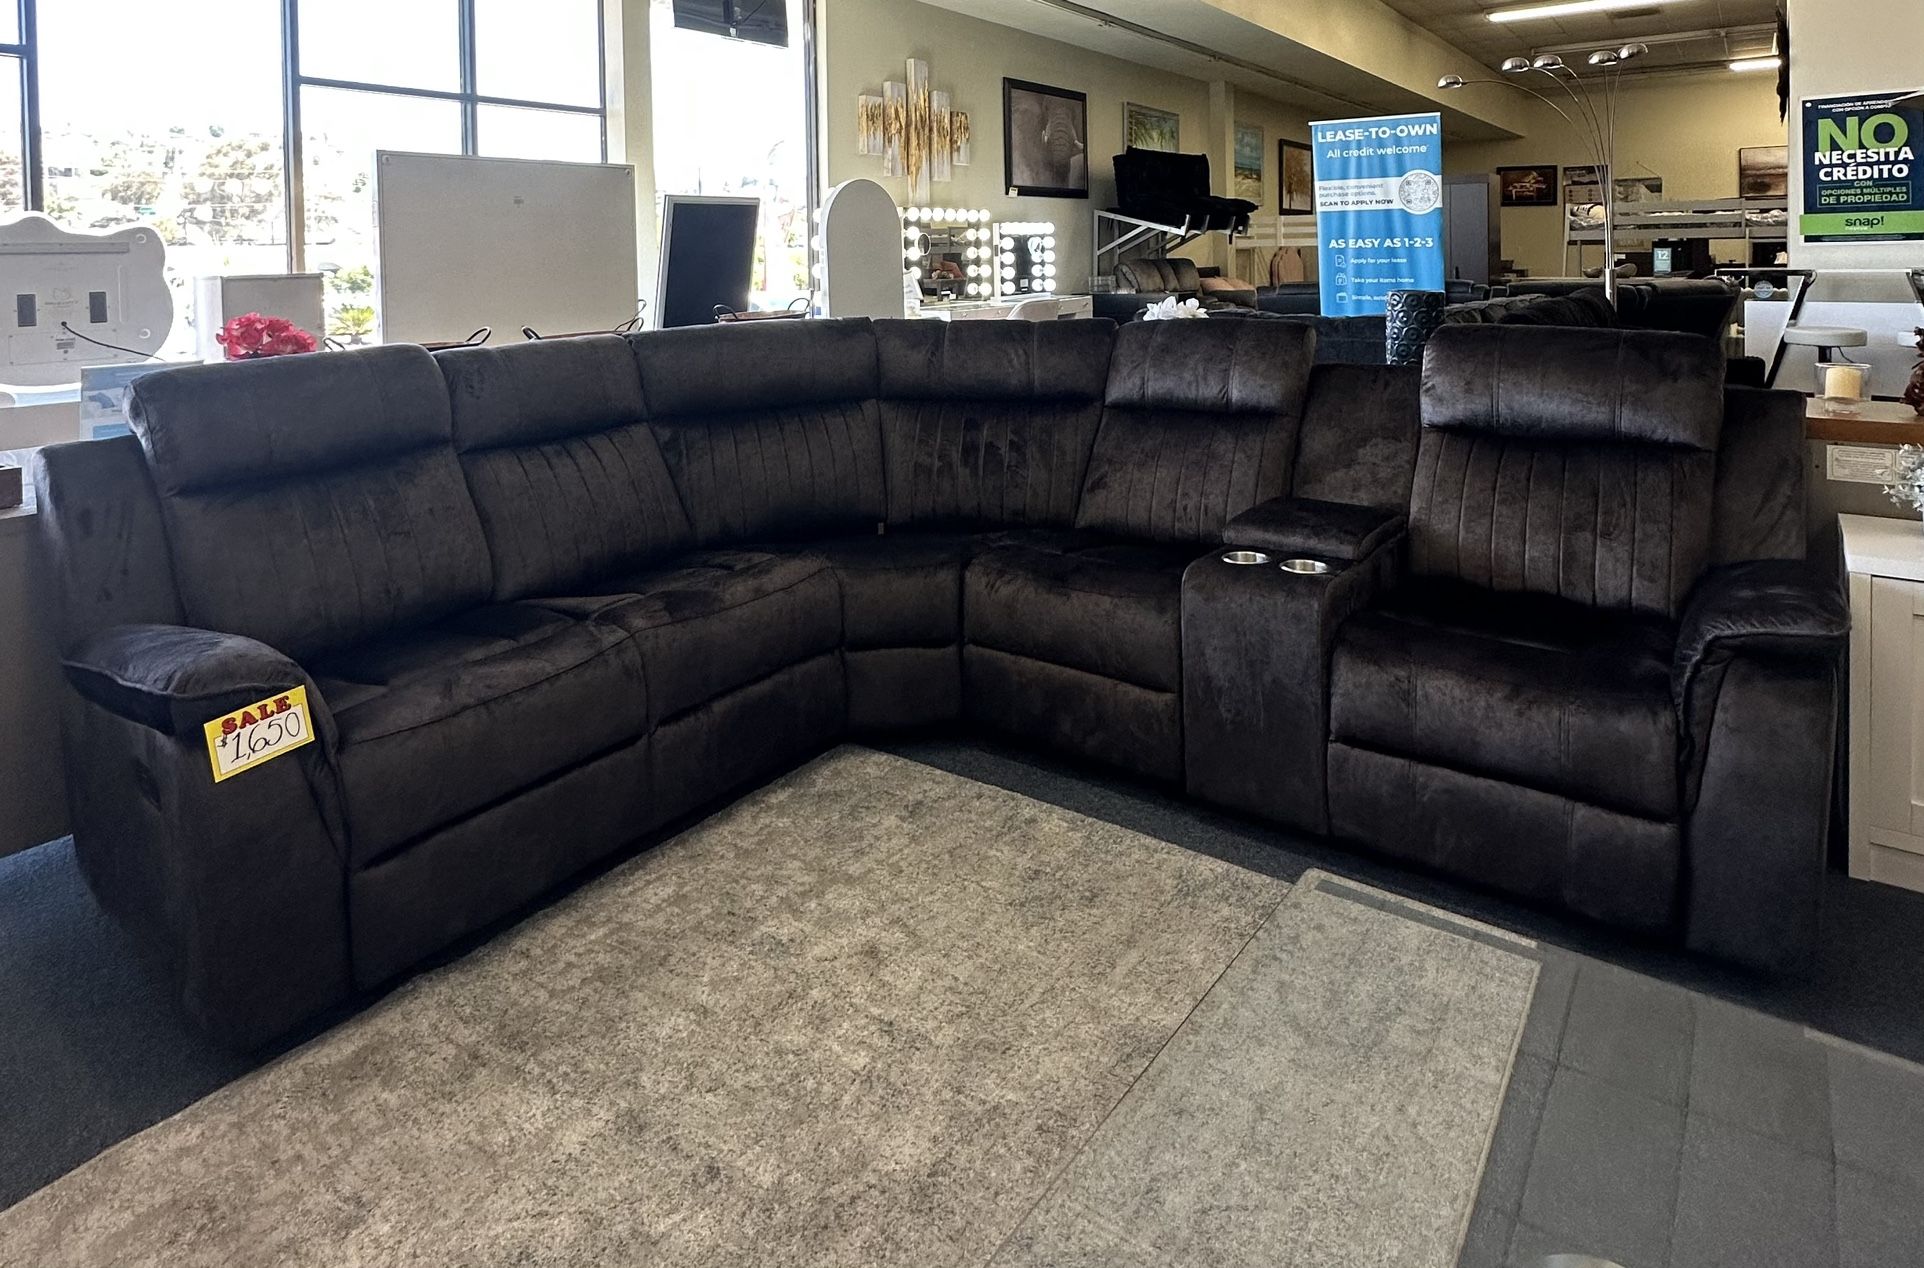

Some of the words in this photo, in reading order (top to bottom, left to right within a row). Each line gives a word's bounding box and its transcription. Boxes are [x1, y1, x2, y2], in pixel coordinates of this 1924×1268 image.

[1318, 123, 1438, 142] LEASE-TO-OWN
[1818, 113, 1909, 154] NO
[1327, 149, 1340, 159] All
[1343, 147, 1374, 157] credit
[1814, 147, 1914, 165] NECESITA
[1819, 163, 1909, 181] CRÉDITO
[1821, 188, 1861, 196] OPCIONES
[1821, 196, 1837, 204] DE
[1840, 193, 1908, 203] PROPIEDAD
[1845, 216, 1884, 228] snap!
[1329, 239, 1346, 248] AS
[1348, 239, 1381, 248] EASY
[1384, 238, 1402, 247] AS
[1404, 238, 1433, 247] 1-2-3
[221, 695, 292, 736] SALE
